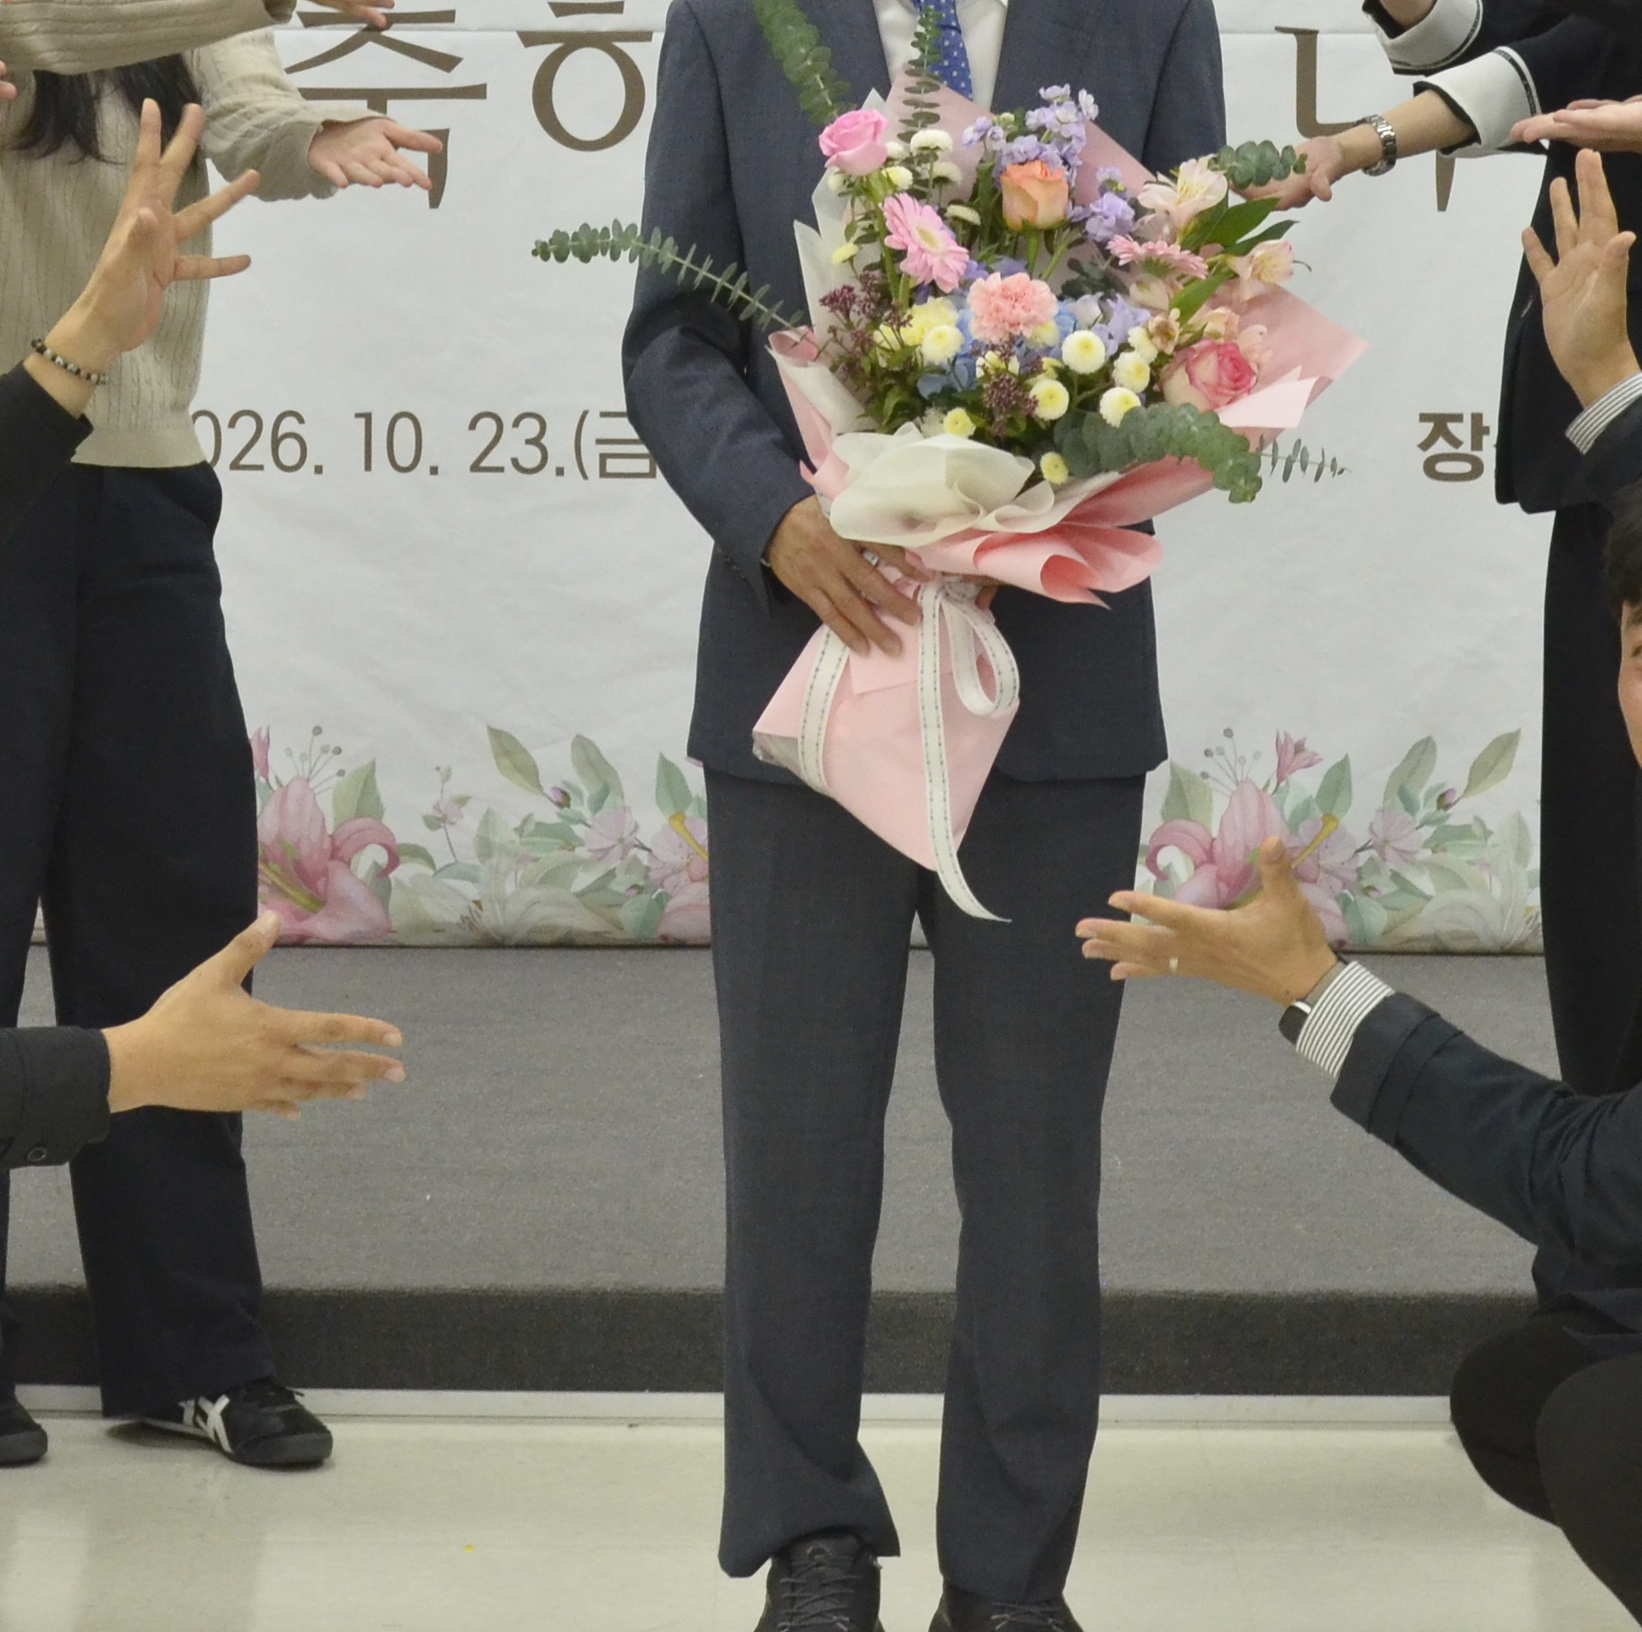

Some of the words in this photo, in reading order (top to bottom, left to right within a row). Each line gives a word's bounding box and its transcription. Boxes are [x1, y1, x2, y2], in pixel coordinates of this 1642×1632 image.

[190, 408, 324, 476] 026.
[353, 410, 440, 477] 10.
[1416, 411, 1499, 483] 장
